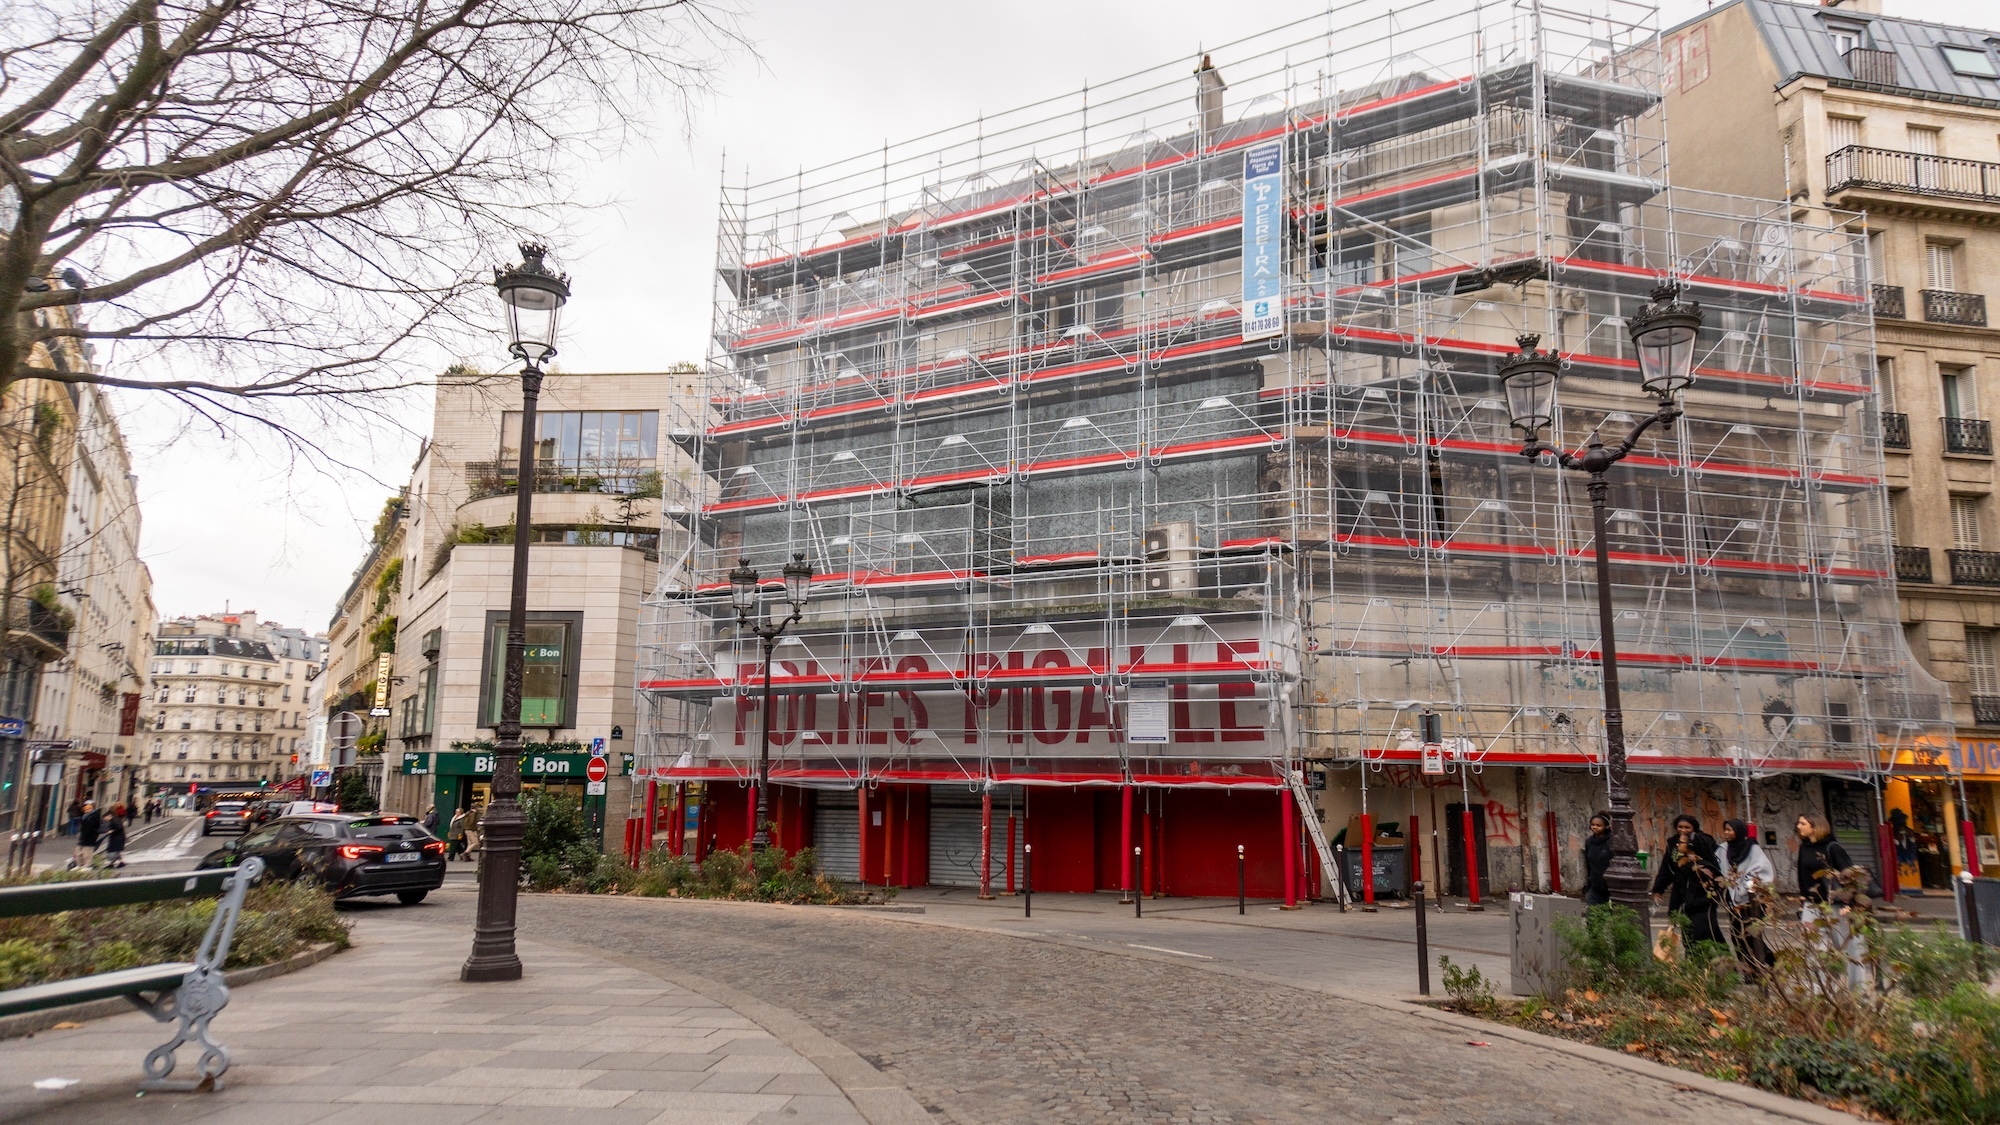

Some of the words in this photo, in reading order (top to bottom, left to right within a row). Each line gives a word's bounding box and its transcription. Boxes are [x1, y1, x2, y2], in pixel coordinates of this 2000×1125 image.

[1253, 204, 1270, 277] PEREIRA
[540, 648, 560, 657] Bon
[378, 654, 388, 694] PIGALLE
[376, 694, 385, 707] LE
[735, 654, 929, 746] FOLIES
[964, 638, 1265, 745] PIGALE
[532, 756, 570, 773] Bon
